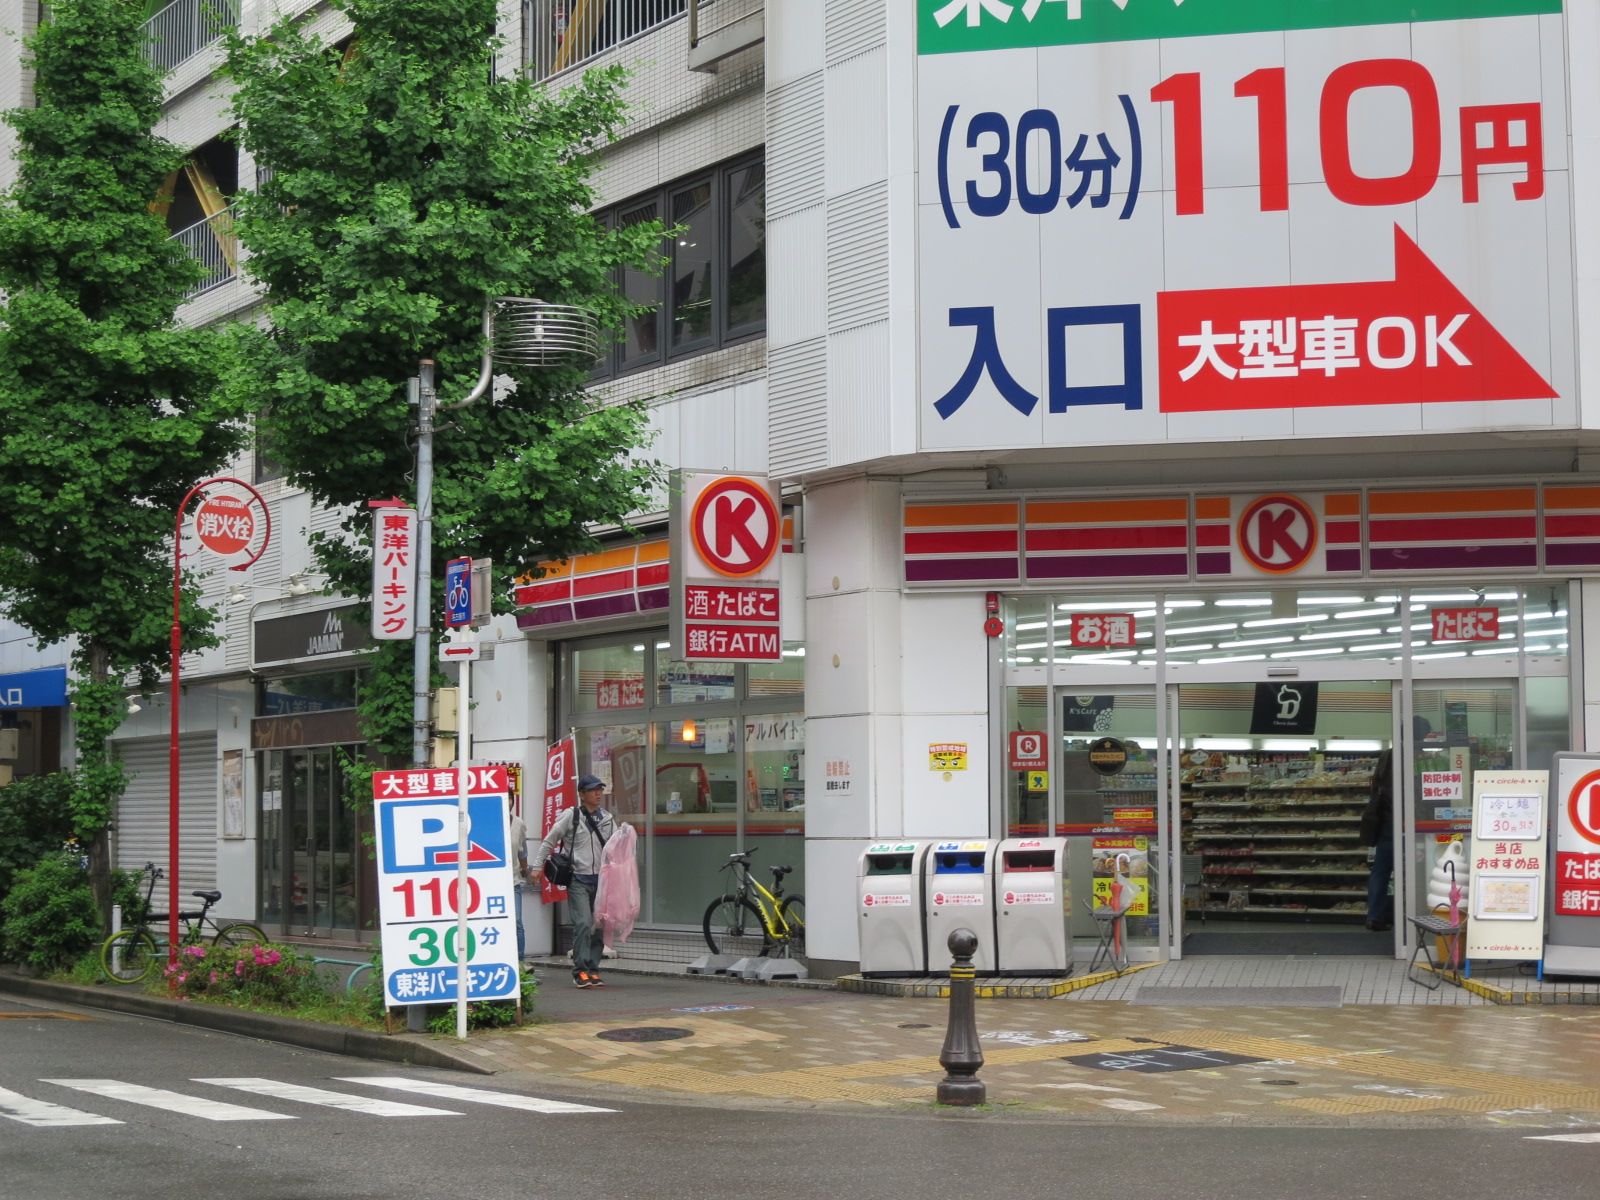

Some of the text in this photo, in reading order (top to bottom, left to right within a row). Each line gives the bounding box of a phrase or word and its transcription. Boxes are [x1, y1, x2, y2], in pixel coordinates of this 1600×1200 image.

[937, 94, 1143, 229] (30分)
[933, 303, 1143, 421] 入口
[1177, 313, 1473, 383] 大型車OK
[199, 513, 252, 541] 消火栓
[381, 514, 409, 635] 東洋パーキング
[688, 587, 777, 618] 酒・たばこ
[1076, 615, 1130, 645] お酒
[1435, 610, 1496, 640] たばこ
[688, 626, 778, 655] 銀行ATM
[598, 685, 619, 705] お酒
[381, 769, 499, 796] 大型車OK
[1423, 773, 1461, 784] 防犯体制
[1476, 857, 1540, 870] おすすめ品
[1495, 843, 1522, 855] 当店
[395, 965, 511, 999] 東洋パーキング
